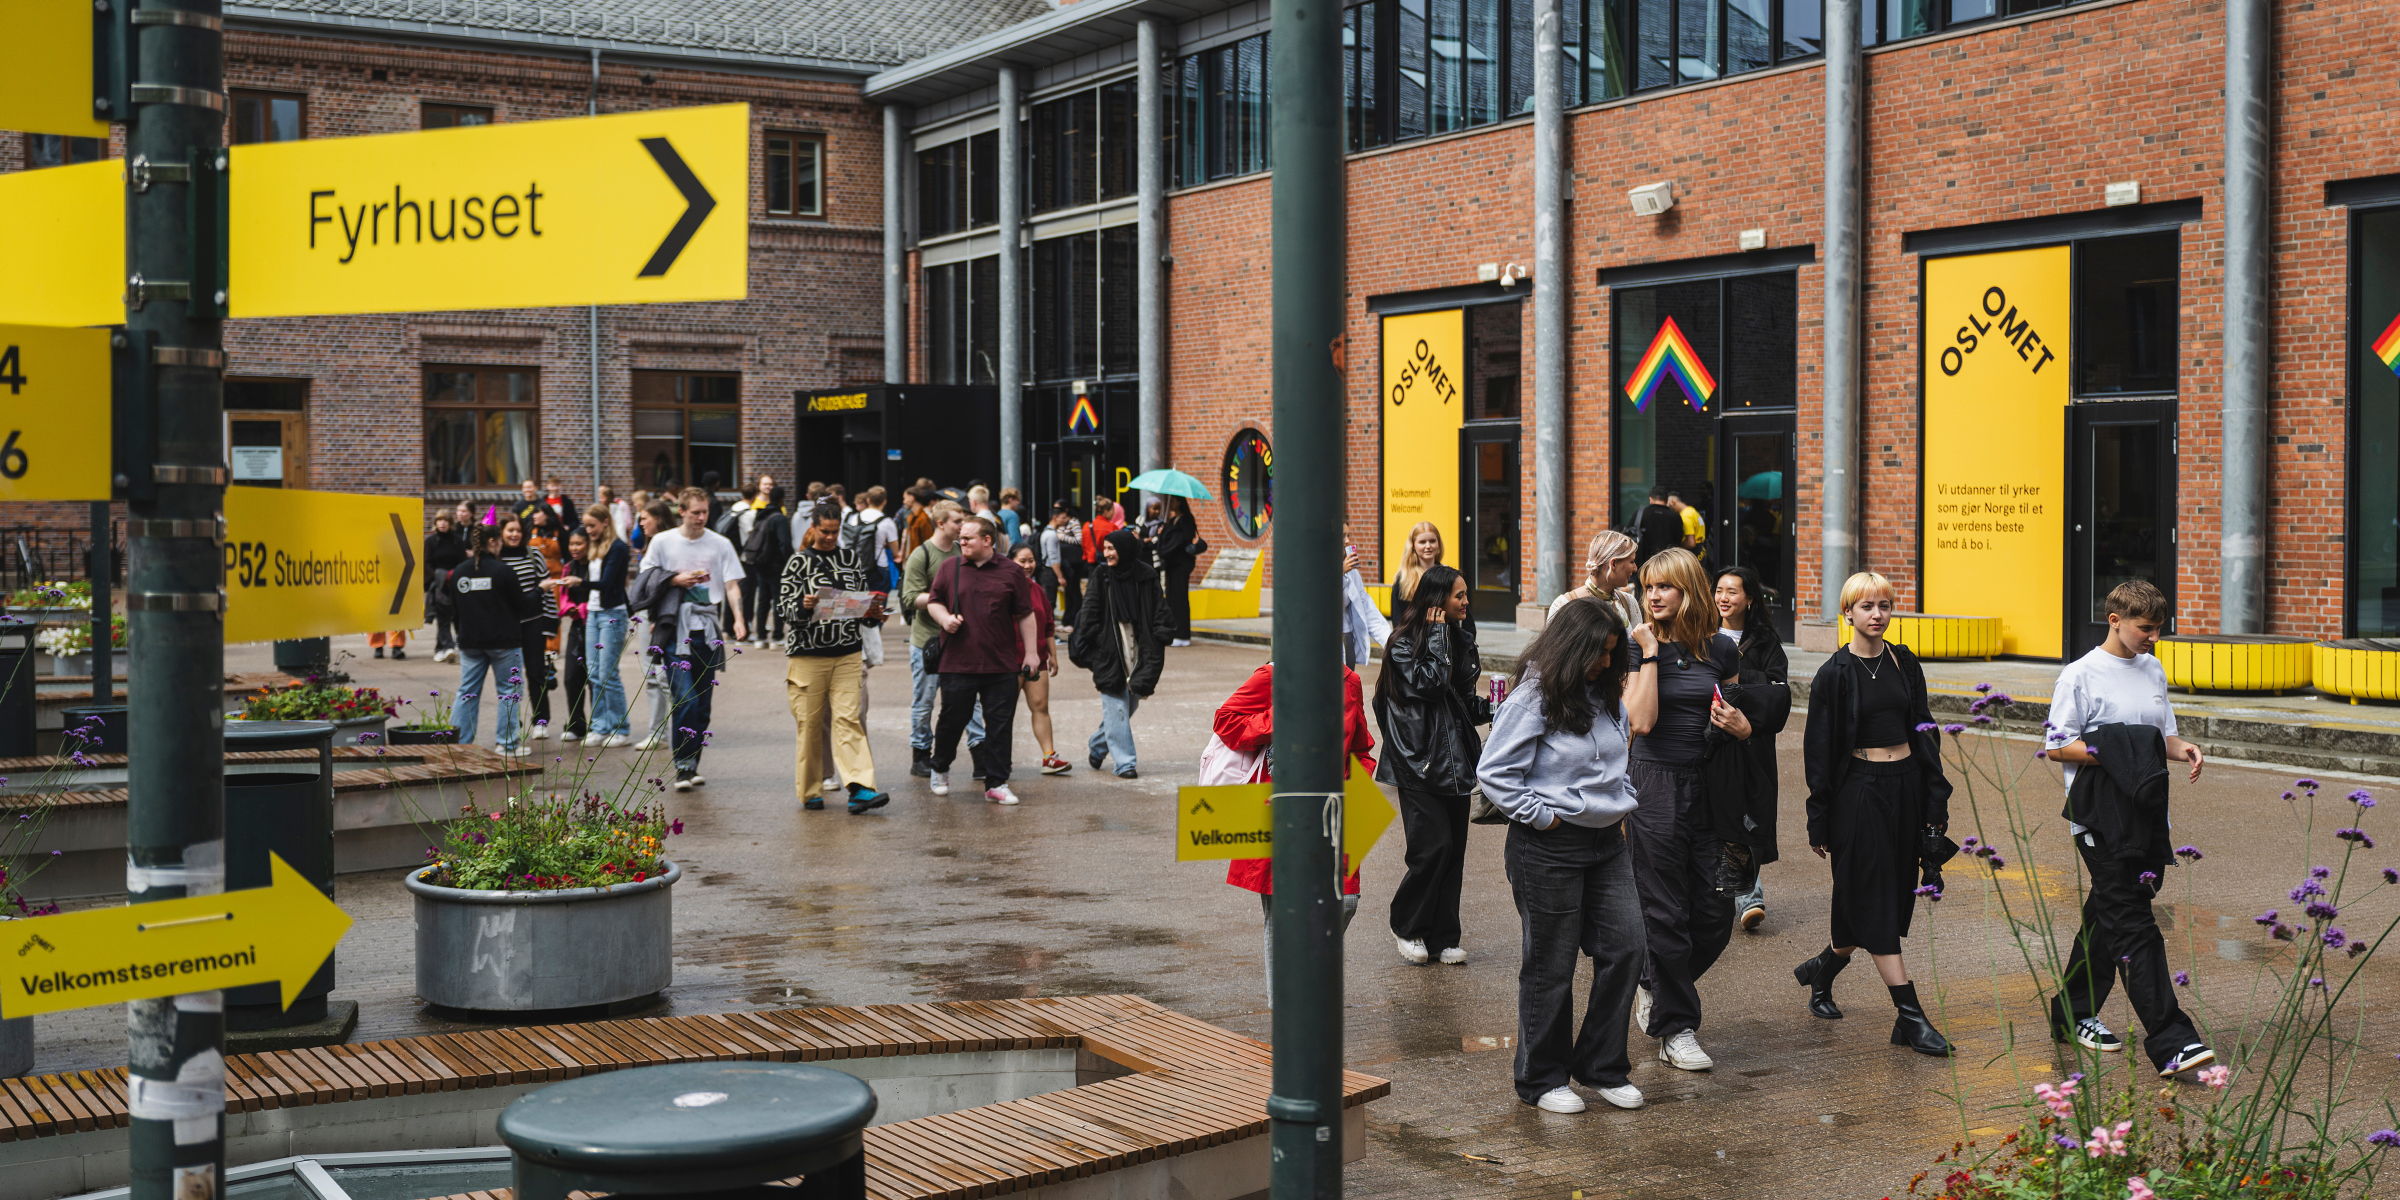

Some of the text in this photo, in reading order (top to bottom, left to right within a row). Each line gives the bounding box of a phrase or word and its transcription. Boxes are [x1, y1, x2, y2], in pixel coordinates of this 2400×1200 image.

[310, 182, 543, 264] Fyrhuset
[1941, 286, 2055, 377] OSLOMET
[1392, 338, 1457, 406] OSLOMET
[0, 430, 29, 480] 6
[1391, 488, 1431, 498] Velkommen!
[1937, 484, 2041, 498] Vi utdanner til yrker
[1391, 503, 1423, 513] Welcome!
[1937, 502, 2043, 516] som gjør Norge til et
[1937, 521, 2024, 533] av verdens beste
[1937, 538, 1992, 550] land å bo i.
[275, 550, 380, 587] Studenthuset
[20, 945, 256, 996] Velkomstseremoni
